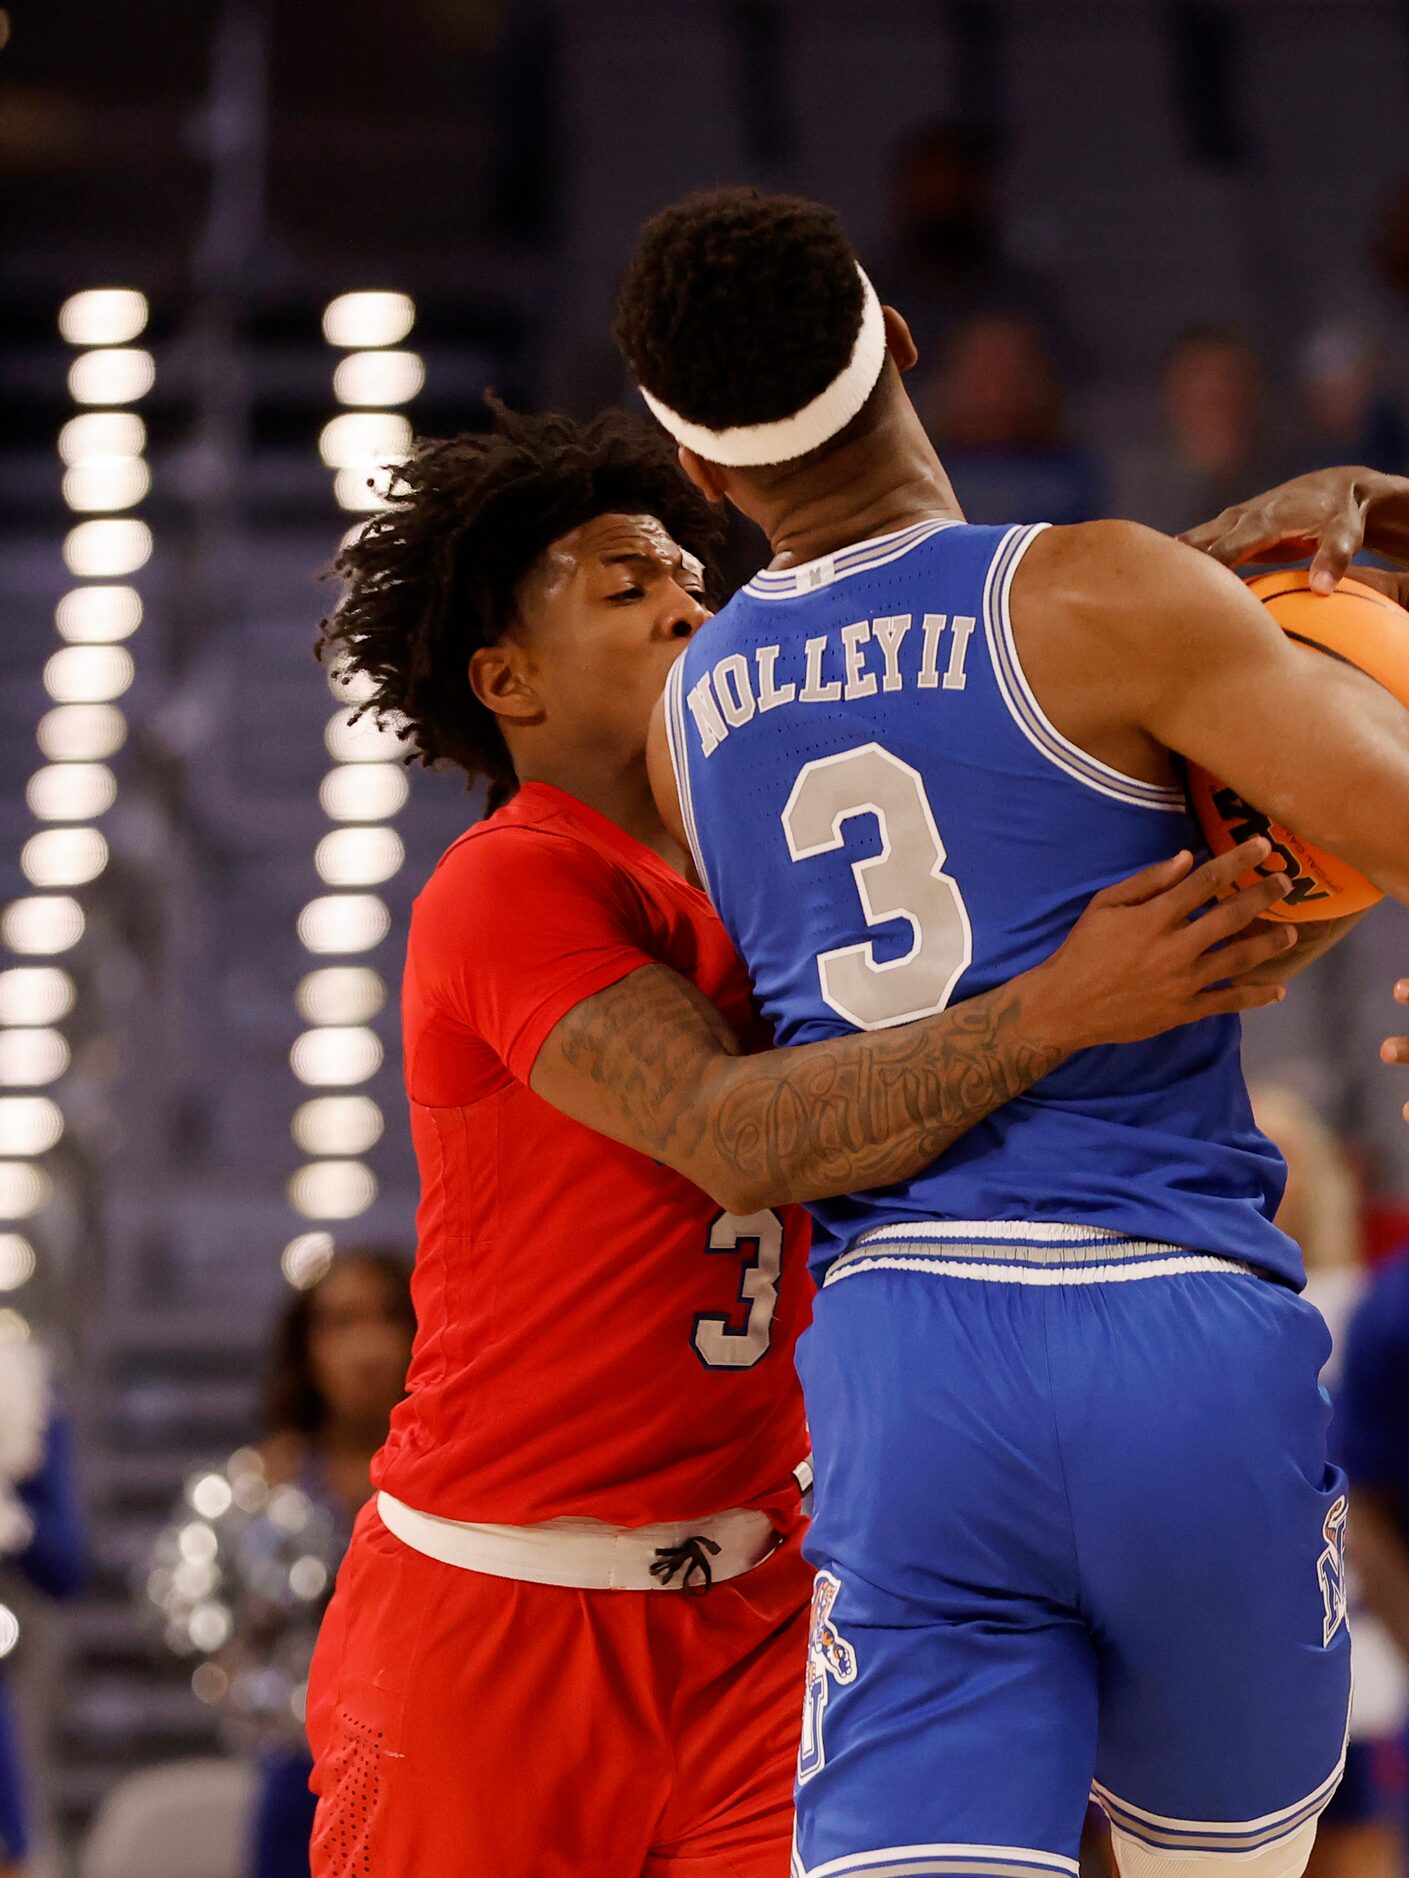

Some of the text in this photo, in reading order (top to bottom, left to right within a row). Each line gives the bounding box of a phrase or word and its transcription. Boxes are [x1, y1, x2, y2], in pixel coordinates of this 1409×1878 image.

[687, 614, 976, 757] NOLLEY II
[781, 742, 974, 1031] 3
[691, 1208, 783, 1370] 3
